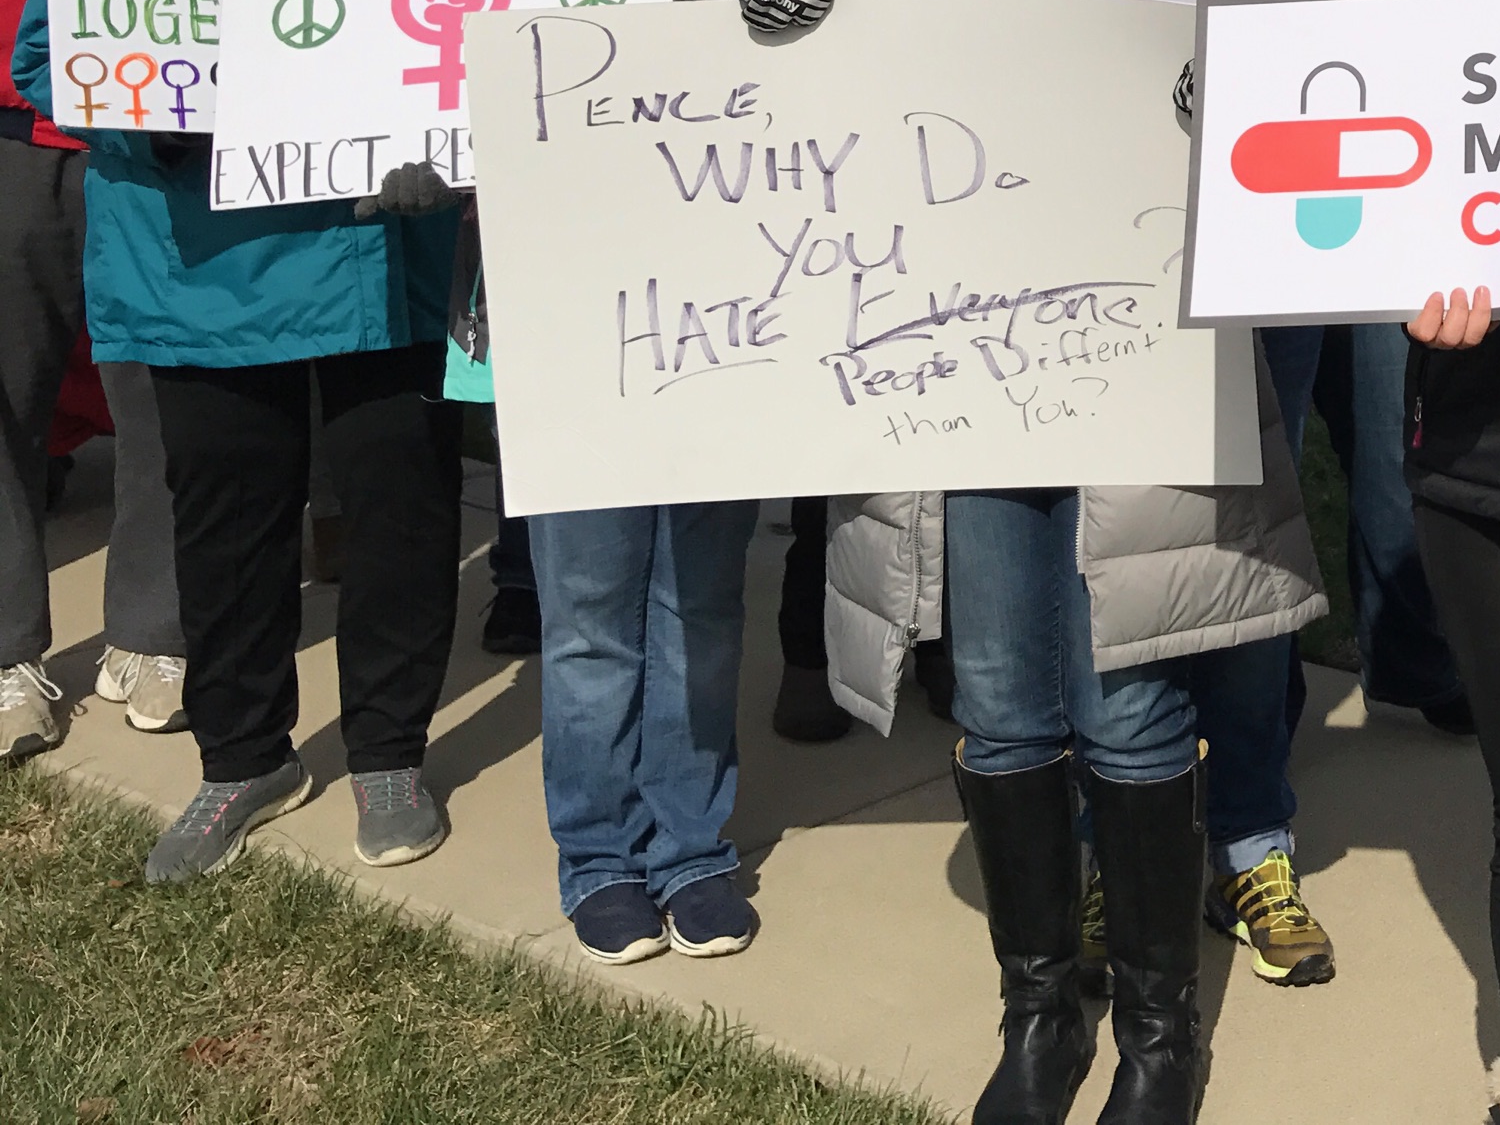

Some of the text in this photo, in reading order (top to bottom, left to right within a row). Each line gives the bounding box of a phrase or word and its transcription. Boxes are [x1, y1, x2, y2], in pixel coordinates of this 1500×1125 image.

[517, 15, 773, 142] PENCE,
[214, 135, 390, 206] EXPECT
[655, 132, 859, 213] WHY
[757, 218, 908, 298] YOU
[617, 278, 788, 397] HATE
[883, 411, 972, 445] than
